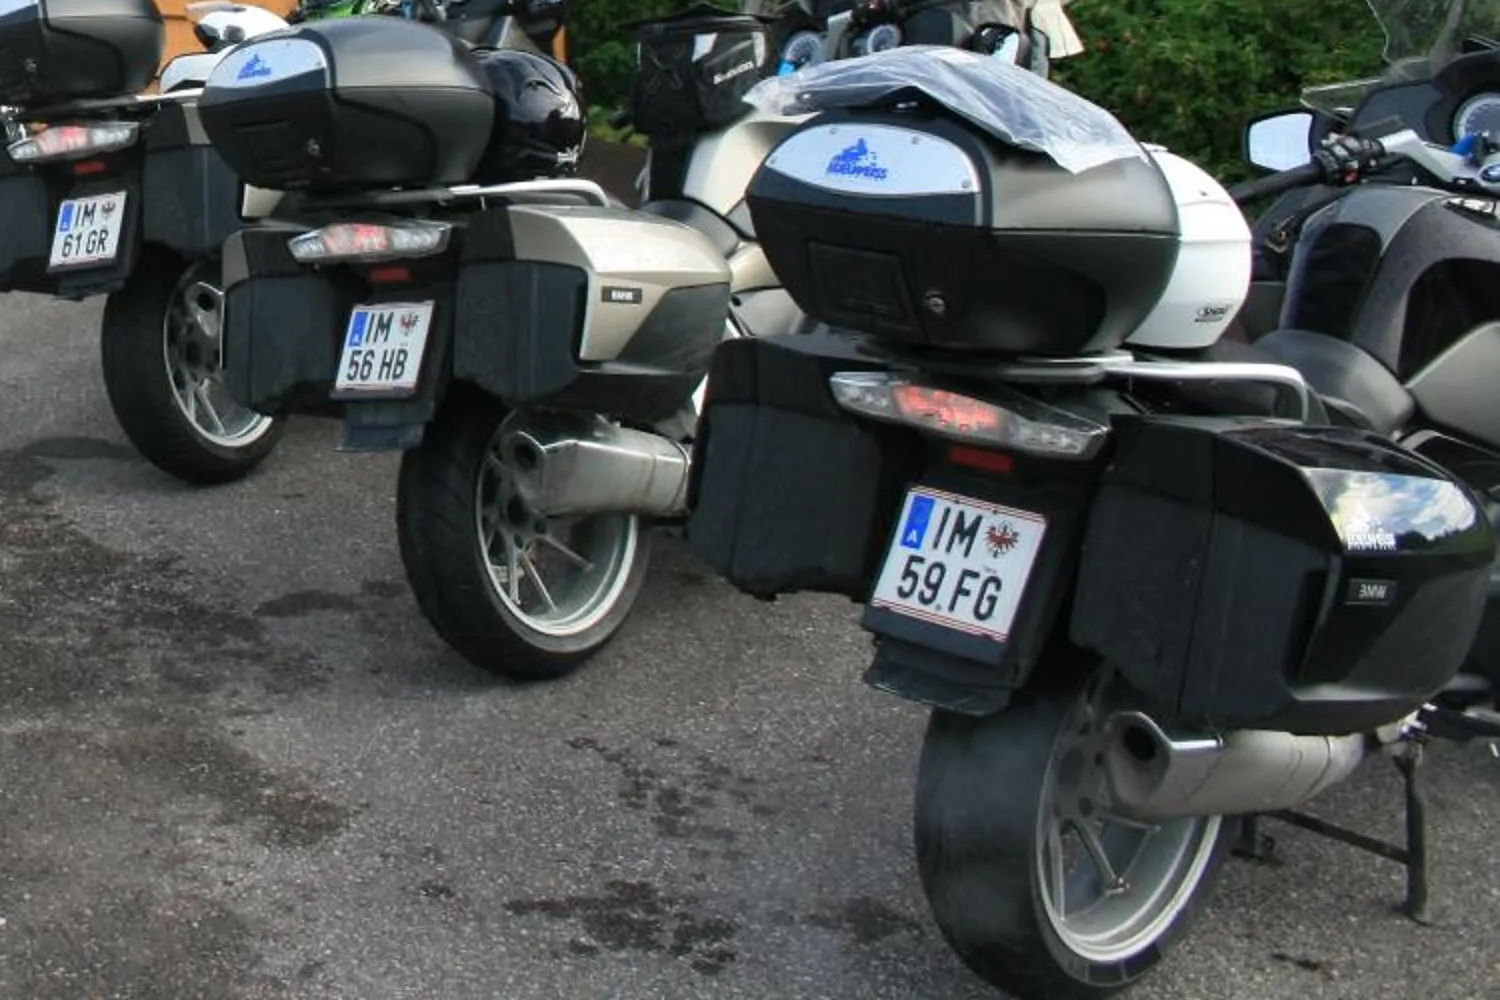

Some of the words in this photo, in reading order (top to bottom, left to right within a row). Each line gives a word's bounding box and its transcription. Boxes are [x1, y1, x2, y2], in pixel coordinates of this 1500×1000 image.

[75, 201, 97, 227] IM
[62, 232, 83, 258] 61
[85, 228, 109, 255] GR
[365, 311, 395, 344] IM
[346, 349, 376, 381] 56
[377, 347, 409, 381] HB
[906, 530, 918, 543] A
[932, 506, 983, 559] IM
[897, 554, 947, 605] 59
[947, 567, 1003, 621] FG
